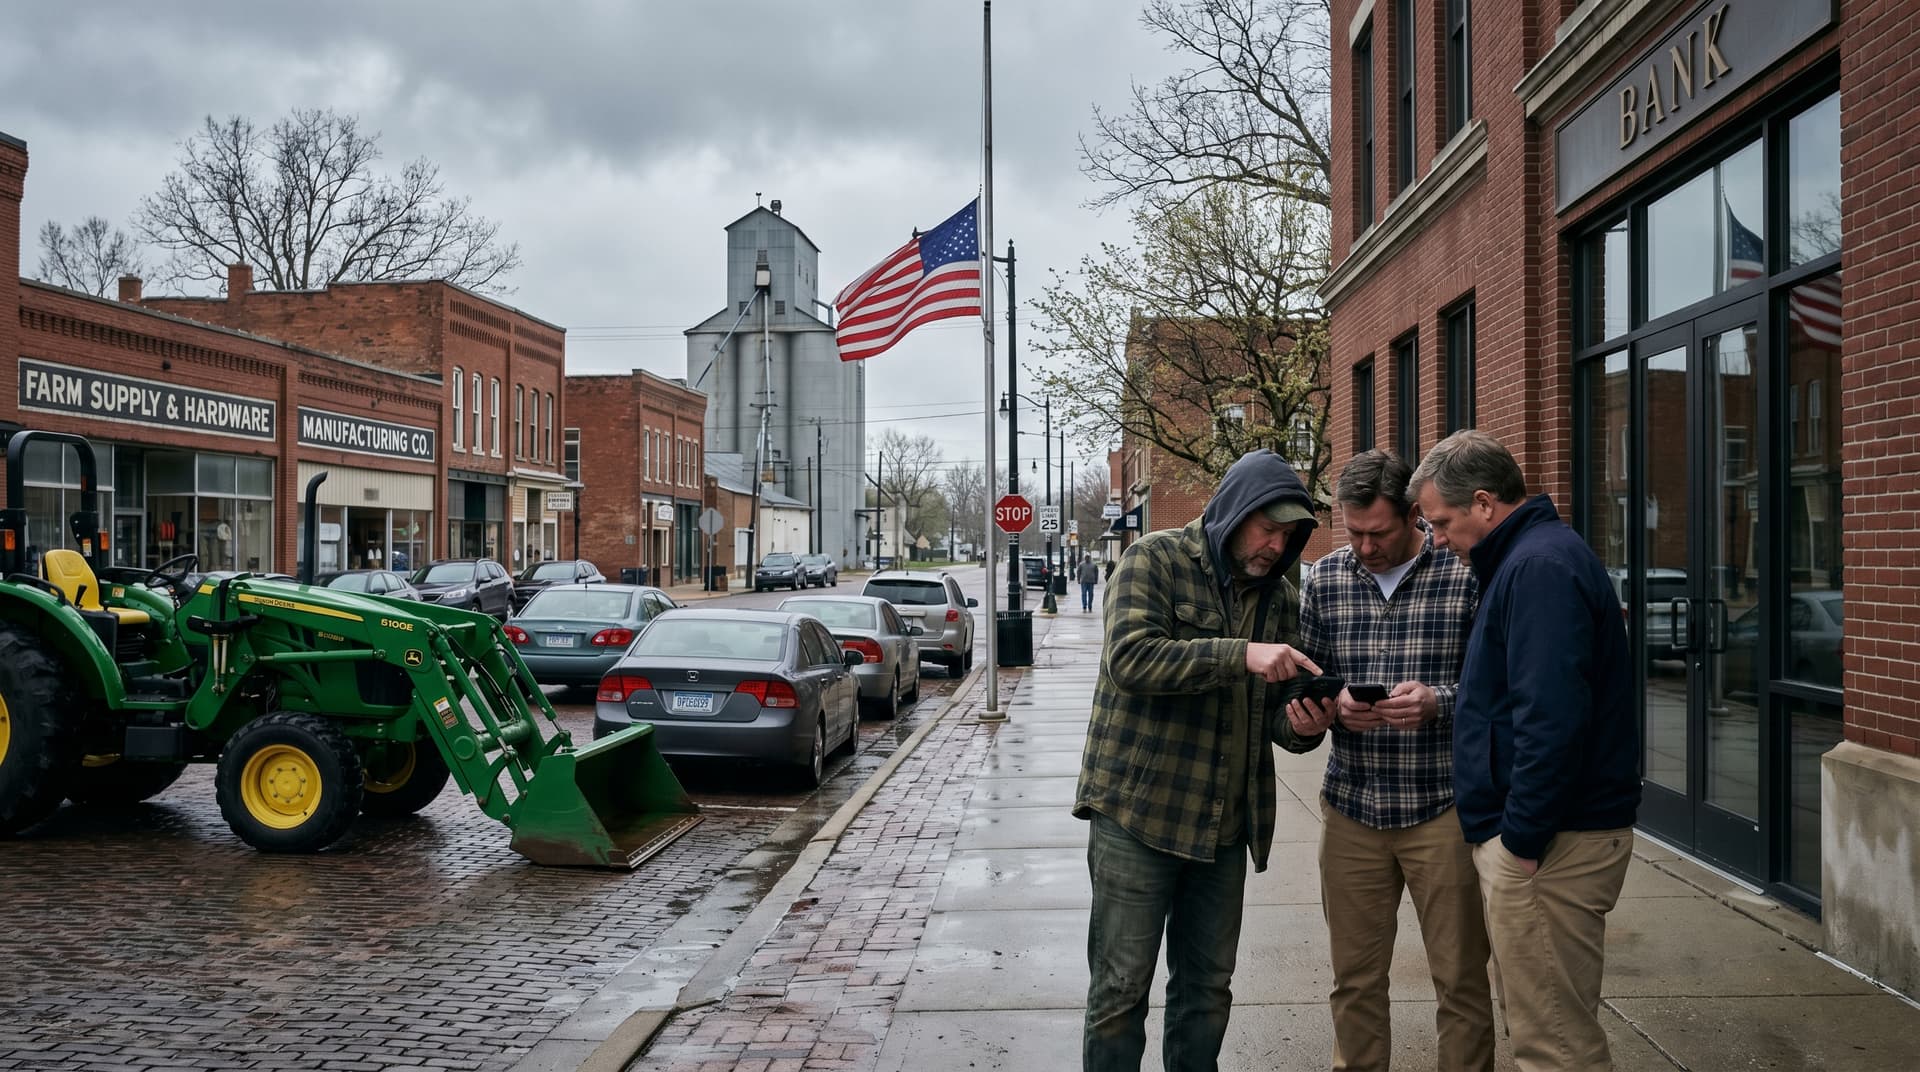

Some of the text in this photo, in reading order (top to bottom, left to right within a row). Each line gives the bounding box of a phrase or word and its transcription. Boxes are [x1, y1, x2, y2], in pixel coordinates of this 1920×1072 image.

[1618, 3, 1733, 150] BANK
[26, 369, 270, 433] FARM SUPPLY & HARDWARE
[303, 415, 430, 455] MANUFACTURING CO.
[996, 507, 1031, 521] STOP
[1041, 519, 1058, 530] 25
